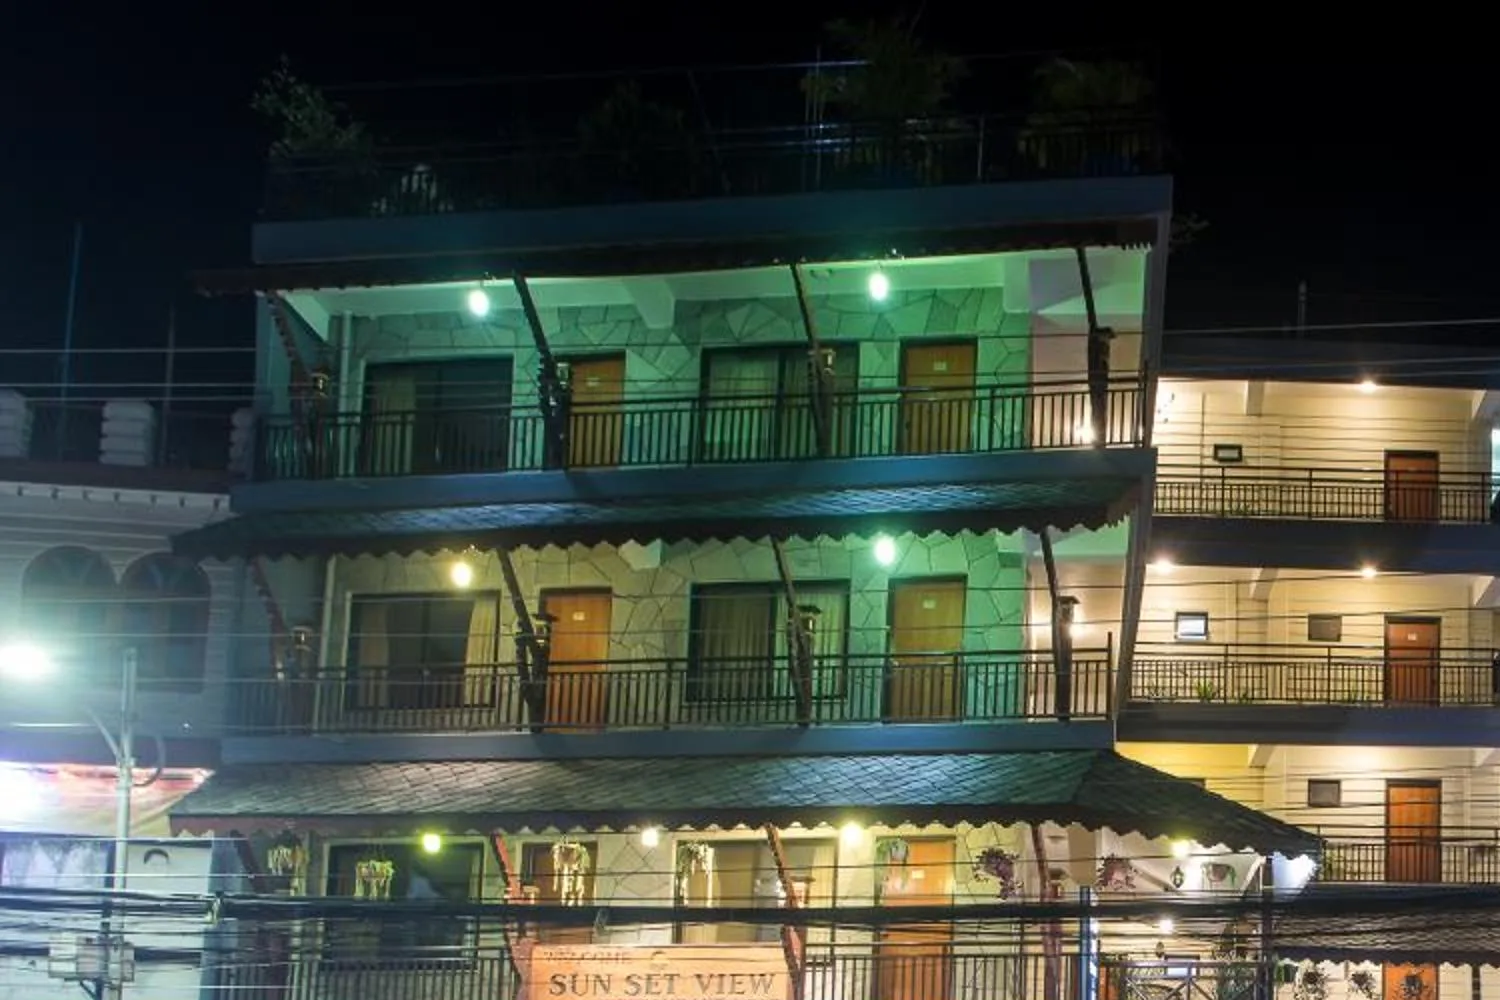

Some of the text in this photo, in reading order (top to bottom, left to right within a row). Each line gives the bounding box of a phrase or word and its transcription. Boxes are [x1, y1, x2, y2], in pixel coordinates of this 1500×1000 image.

[549, 973, 777, 996] SUN SET VIEW
